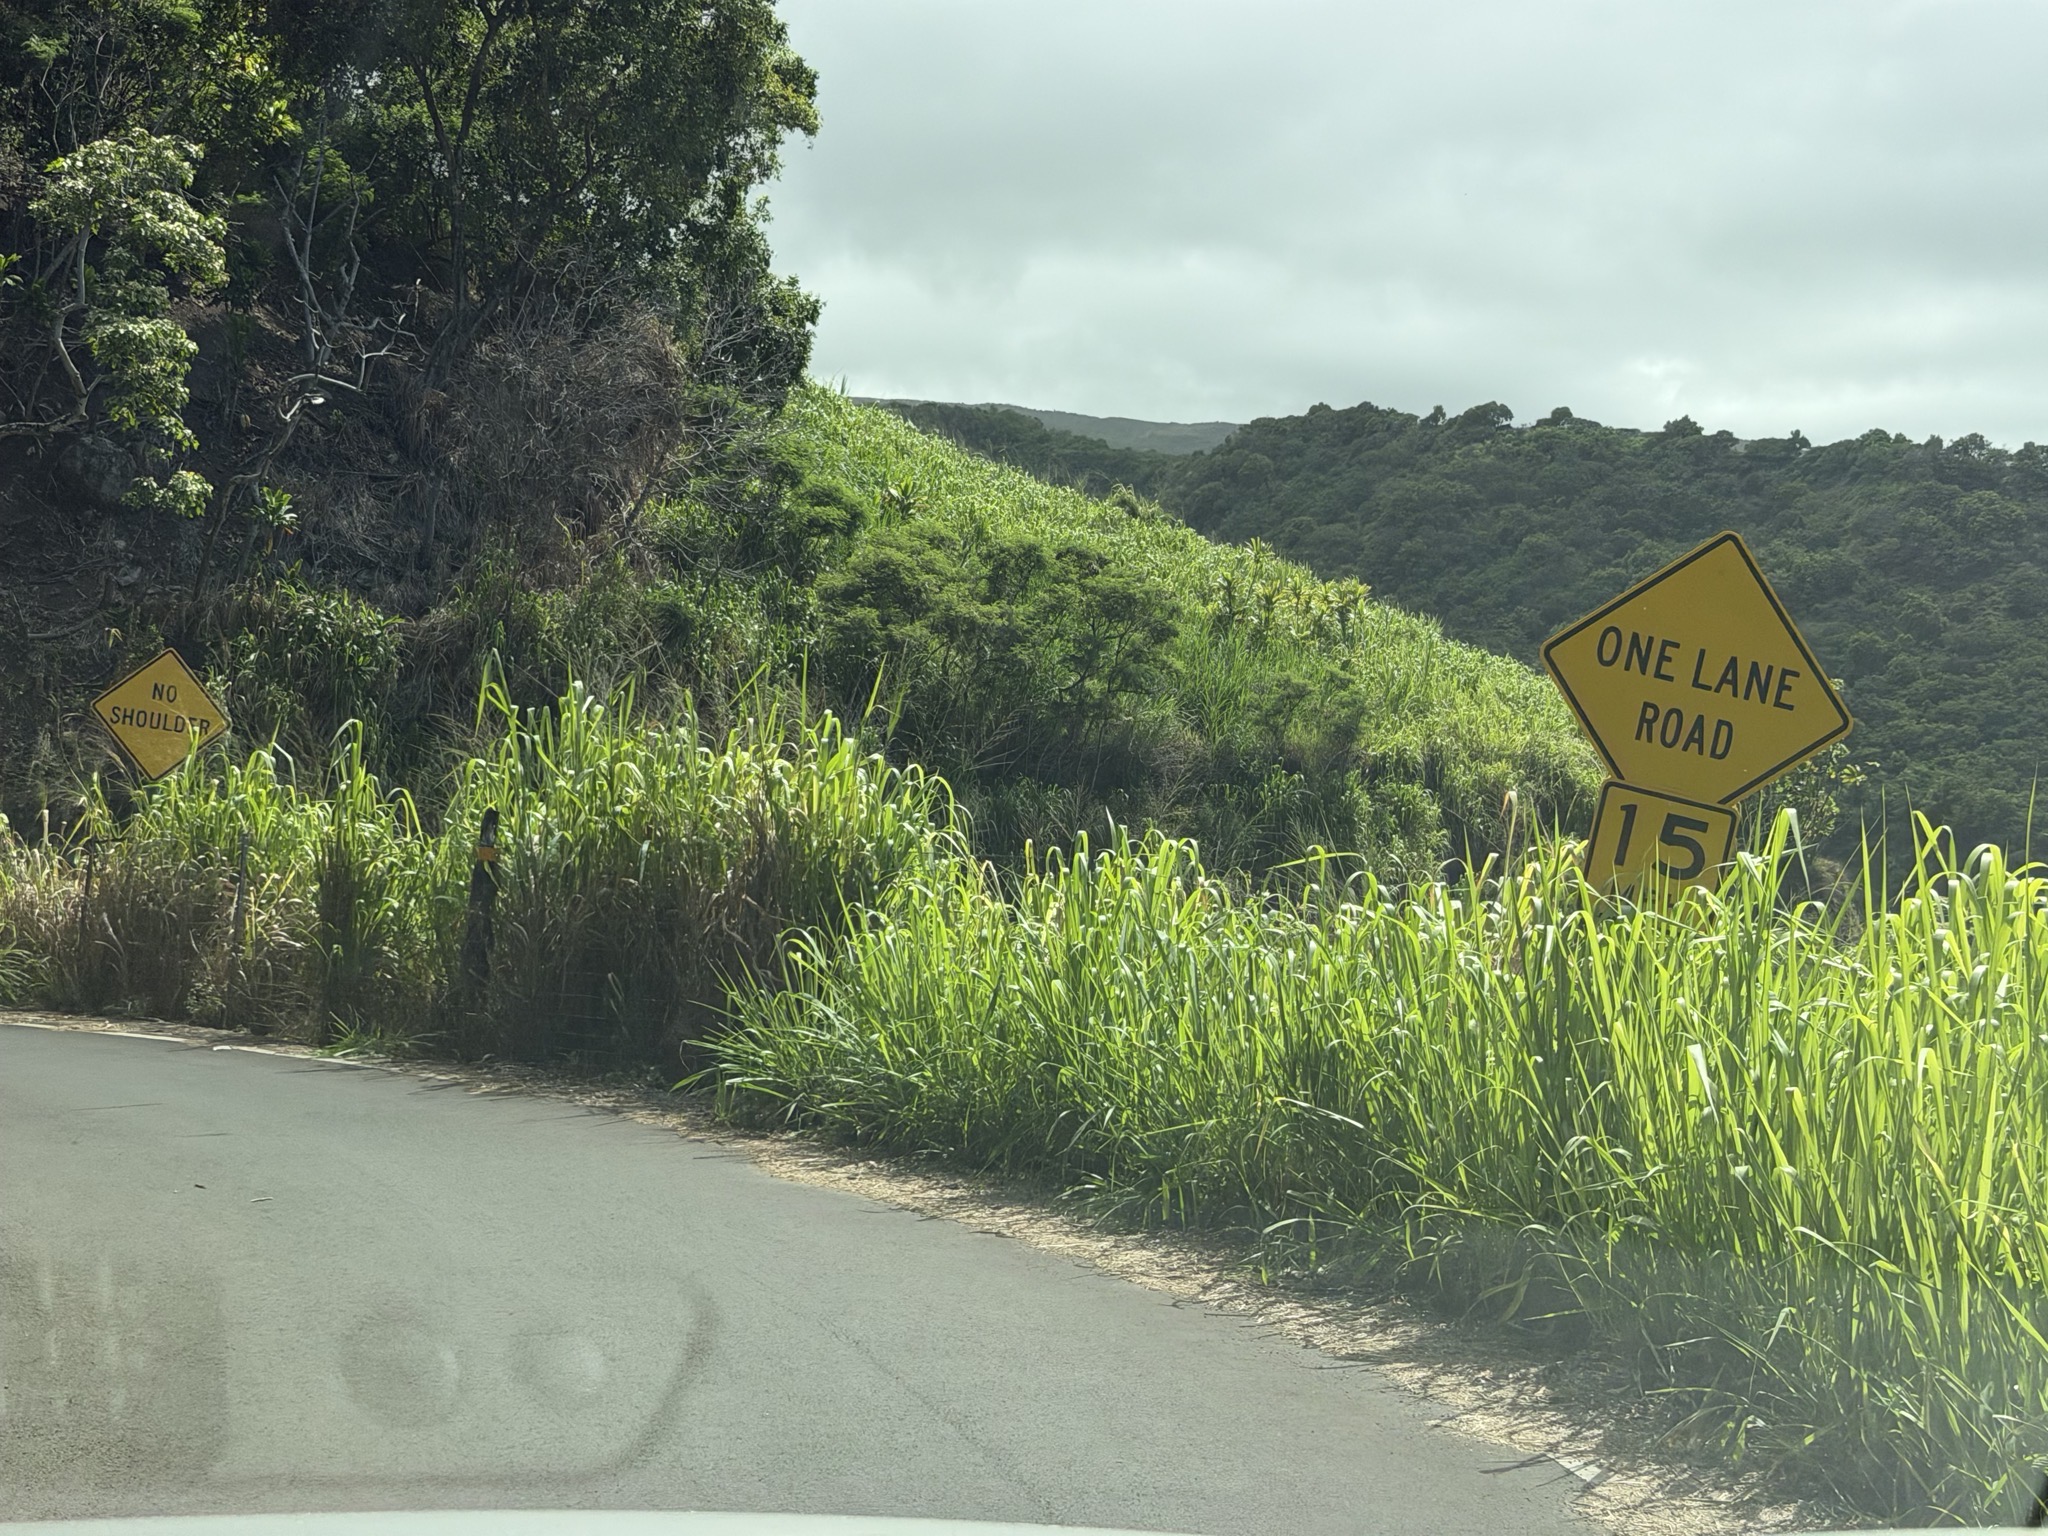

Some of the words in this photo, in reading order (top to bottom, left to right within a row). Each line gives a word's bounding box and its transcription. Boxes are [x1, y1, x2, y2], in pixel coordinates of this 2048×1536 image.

[152, 683, 177, 703] NO
[1597, 626, 1680, 682] ONE
[1692, 648, 1800, 711] LANE
[1635, 701, 1733, 760] ROAD
[1613, 804, 1709, 880] 15
